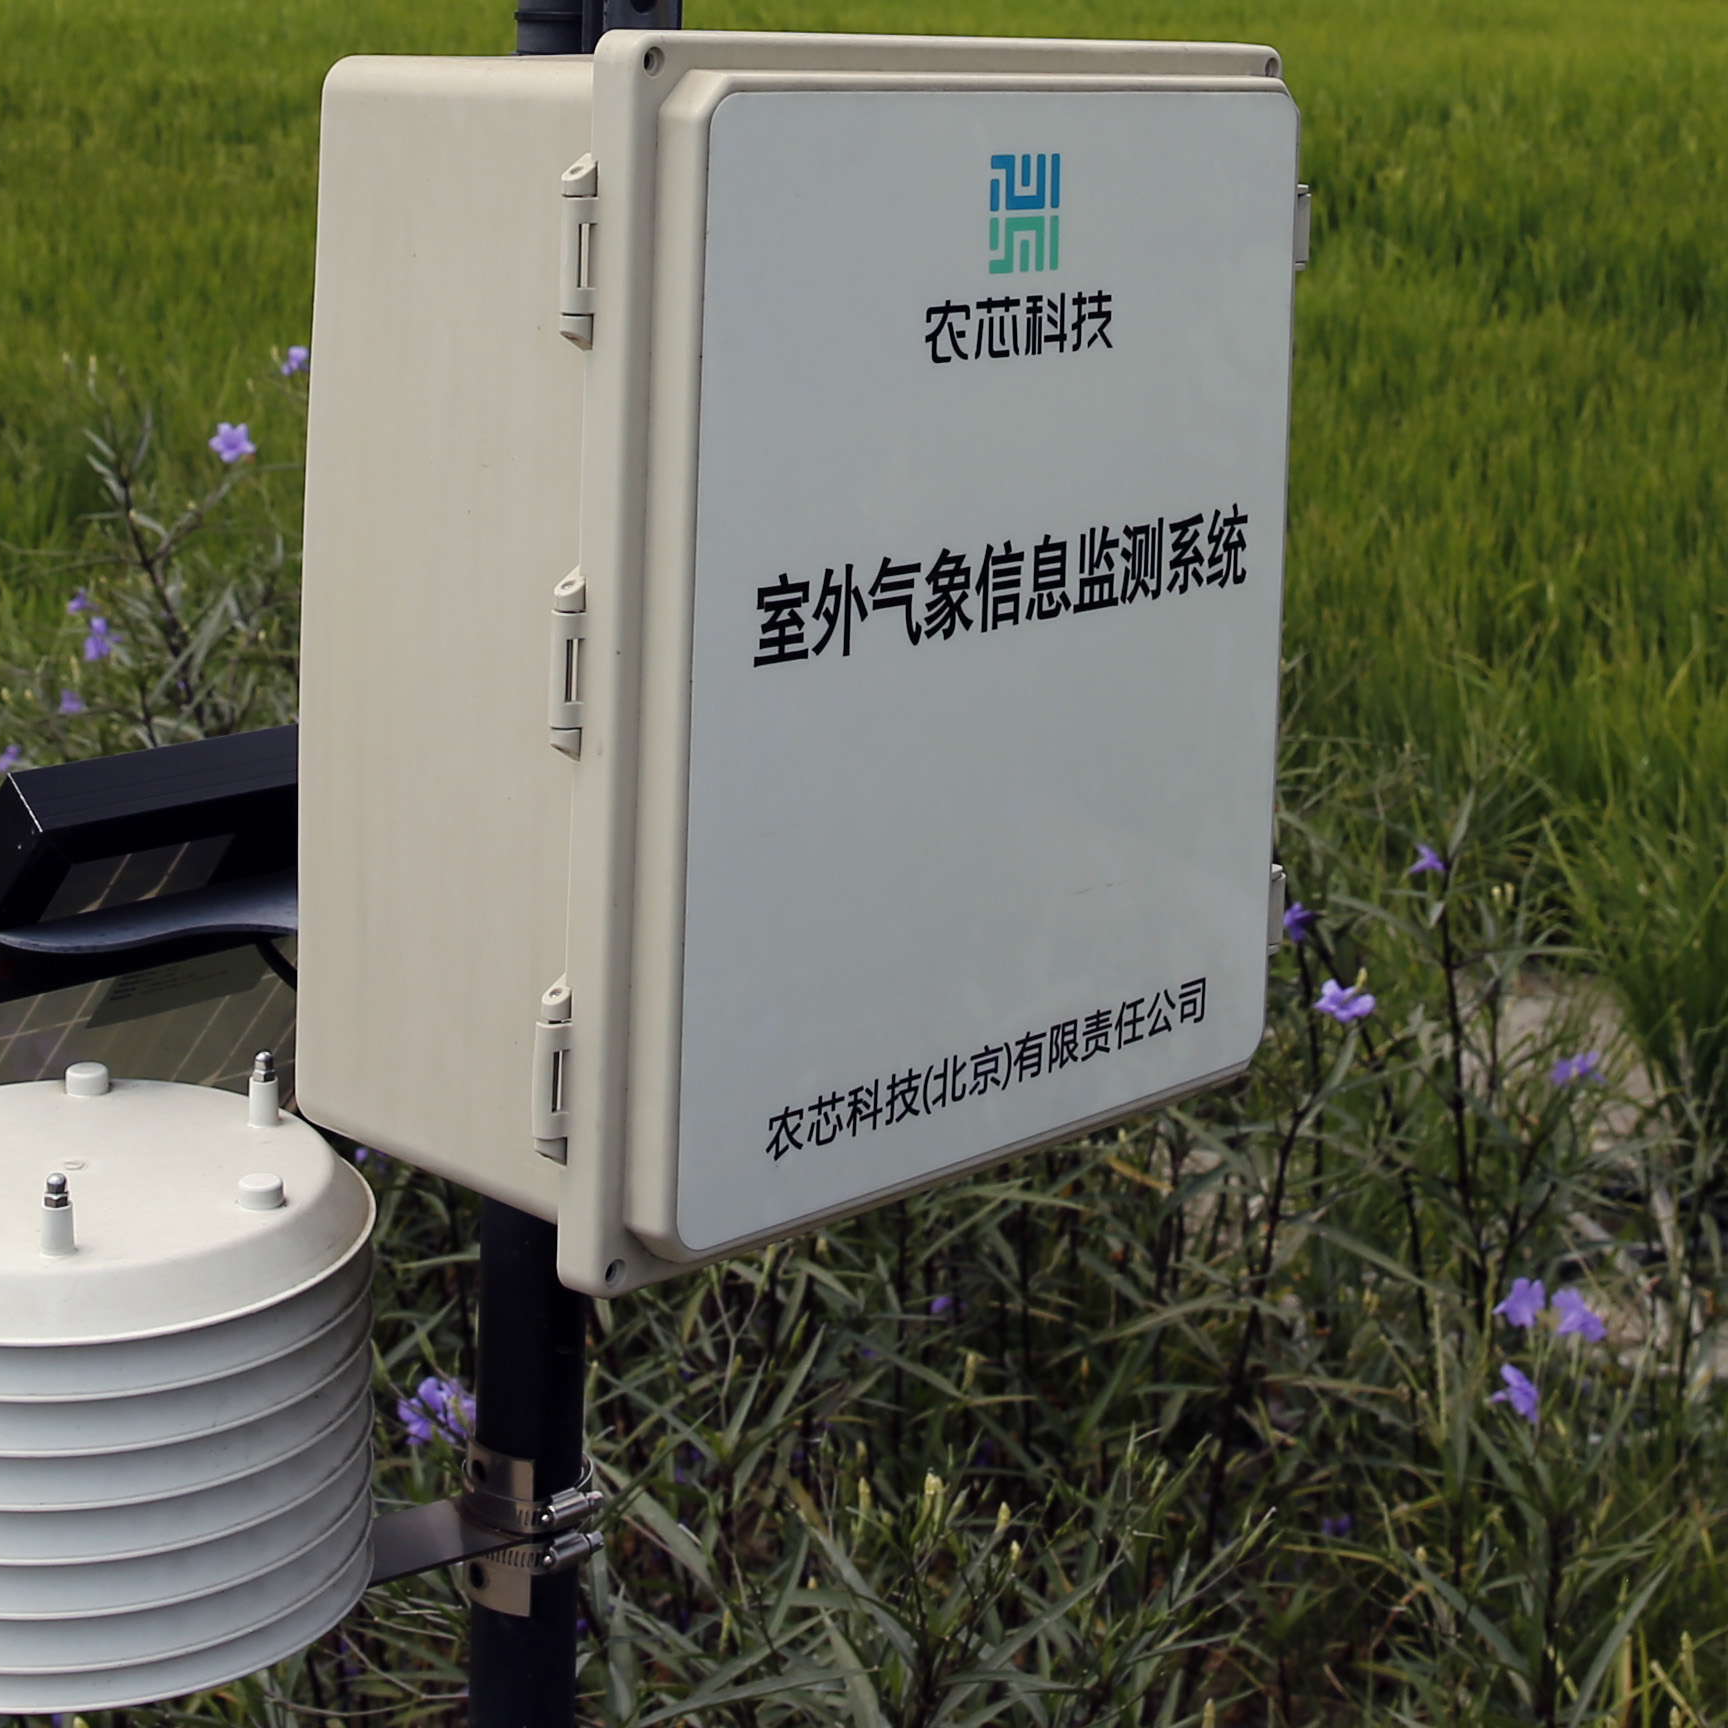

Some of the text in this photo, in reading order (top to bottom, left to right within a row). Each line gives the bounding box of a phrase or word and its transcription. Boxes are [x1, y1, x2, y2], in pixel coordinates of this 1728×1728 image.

[924, 289, 1113, 364] 农芯科技
[753, 502, 1249, 668] 室外气象信息监测系统
